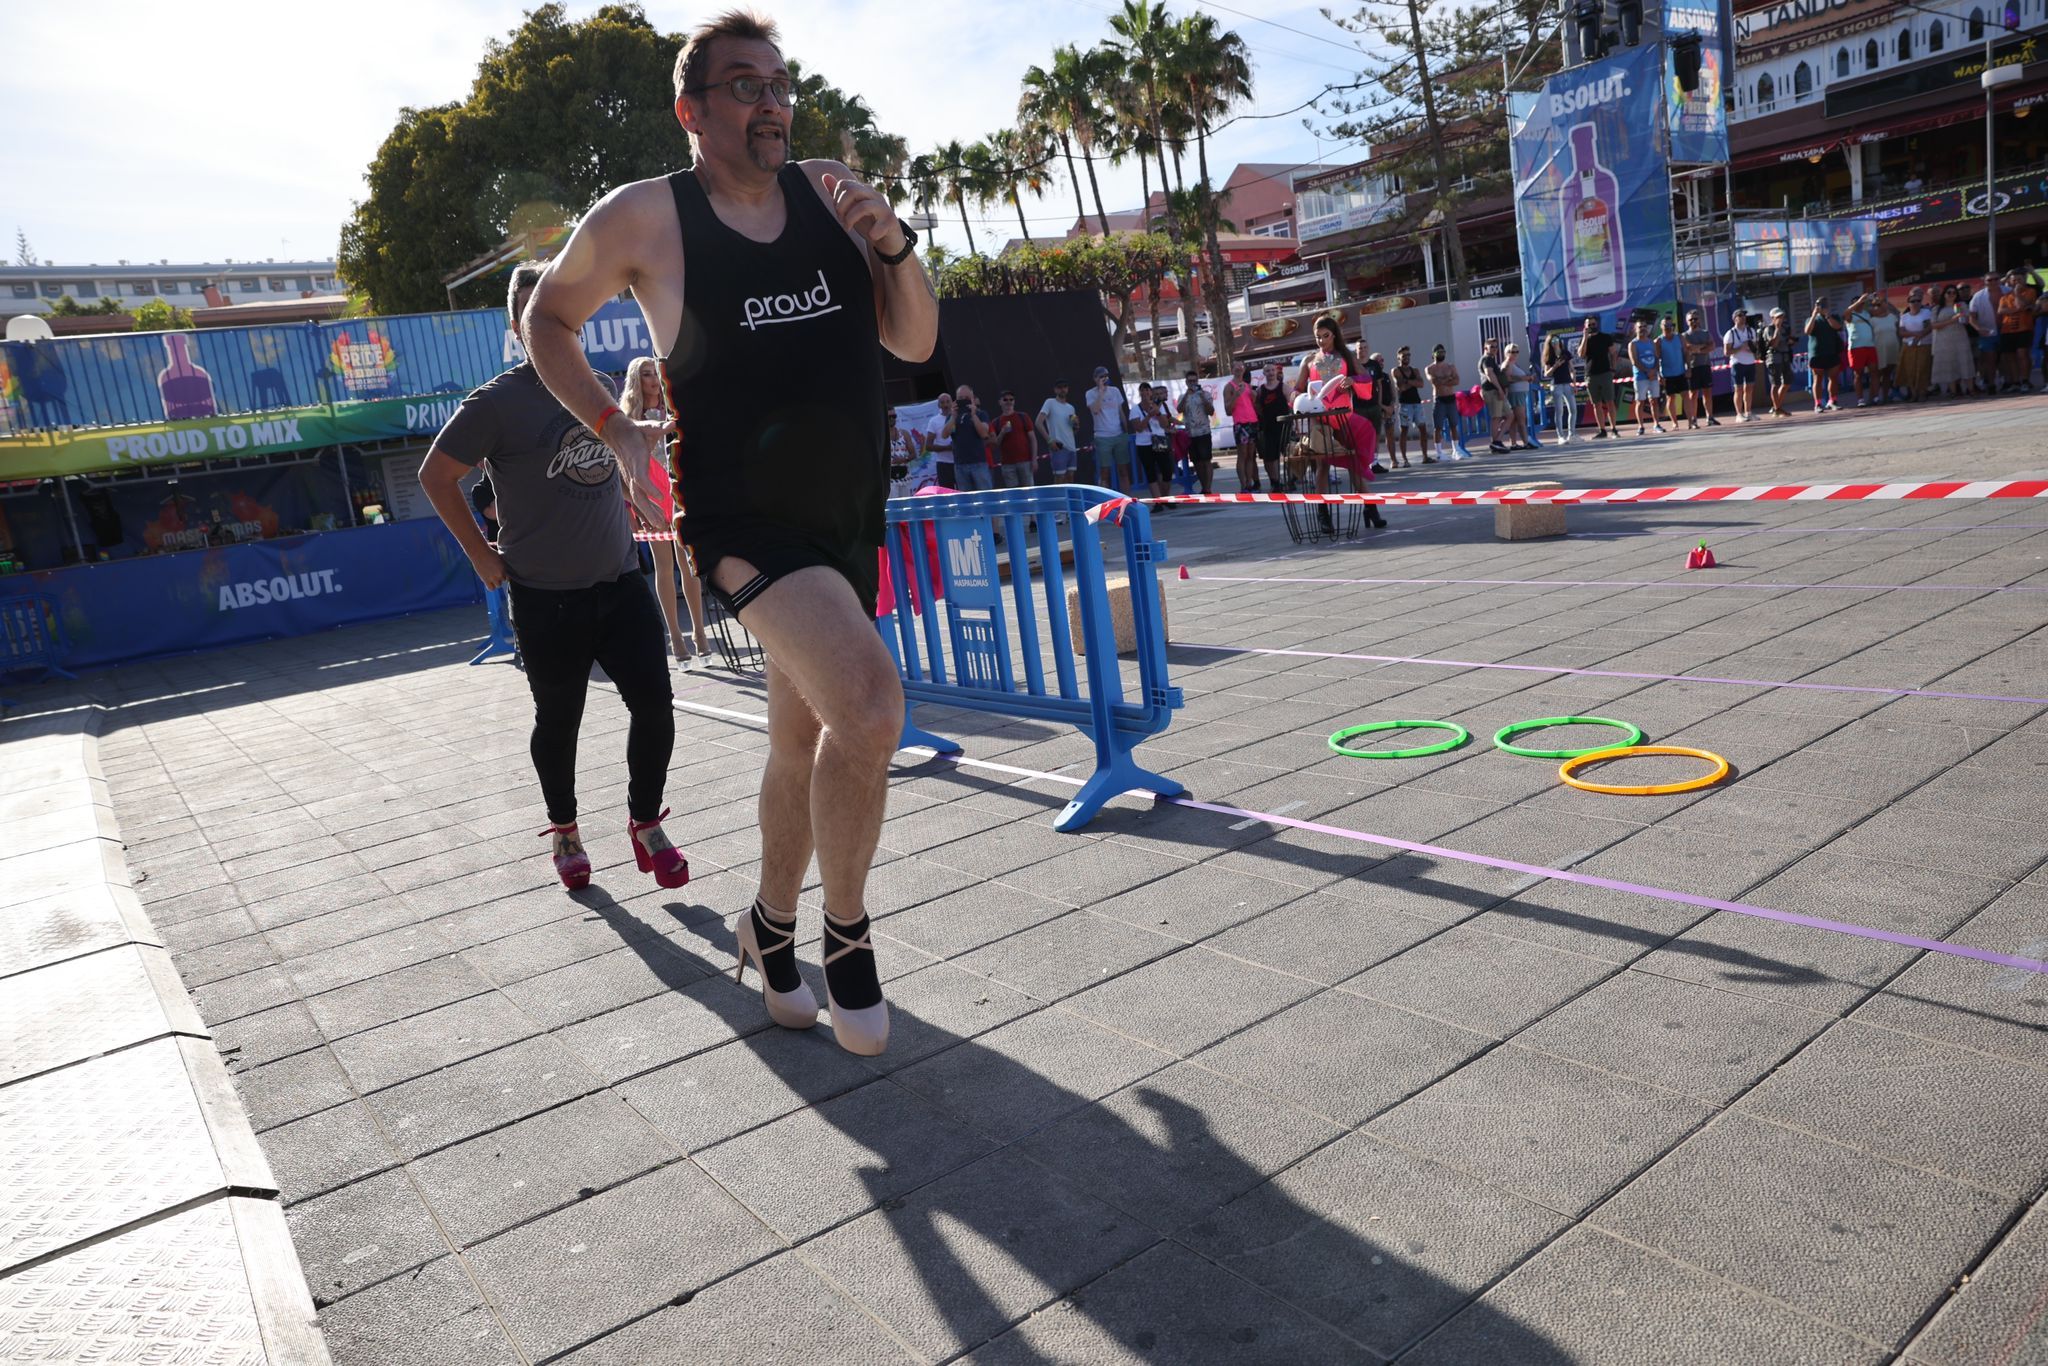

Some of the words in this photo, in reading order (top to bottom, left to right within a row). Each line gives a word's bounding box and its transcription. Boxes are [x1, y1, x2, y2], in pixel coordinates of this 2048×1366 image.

[1788, 30, 1840, 51] STEAK
[1844, 14, 1891, 35] HOUS
[1550, 72, 1632, 118] BSOLUT.
[1307, 171, 1346, 190] Skansen
[1903, 203, 1923, 216] DE
[1281, 263, 1309, 276] COSMOS
[743, 269, 833, 331] proud
[1470, 287, 1481, 299] LE
[503, 317, 649, 363] ALUT.
[341, 350, 385, 367] PRIDE
[107, 427, 209, 462] PROUD
[210, 423, 249, 452] TO
[252, 418, 304, 447] MIX
[219, 569, 343, 611] ABSOLUT.
[953, 578, 989, 588] MASPALOMAS
